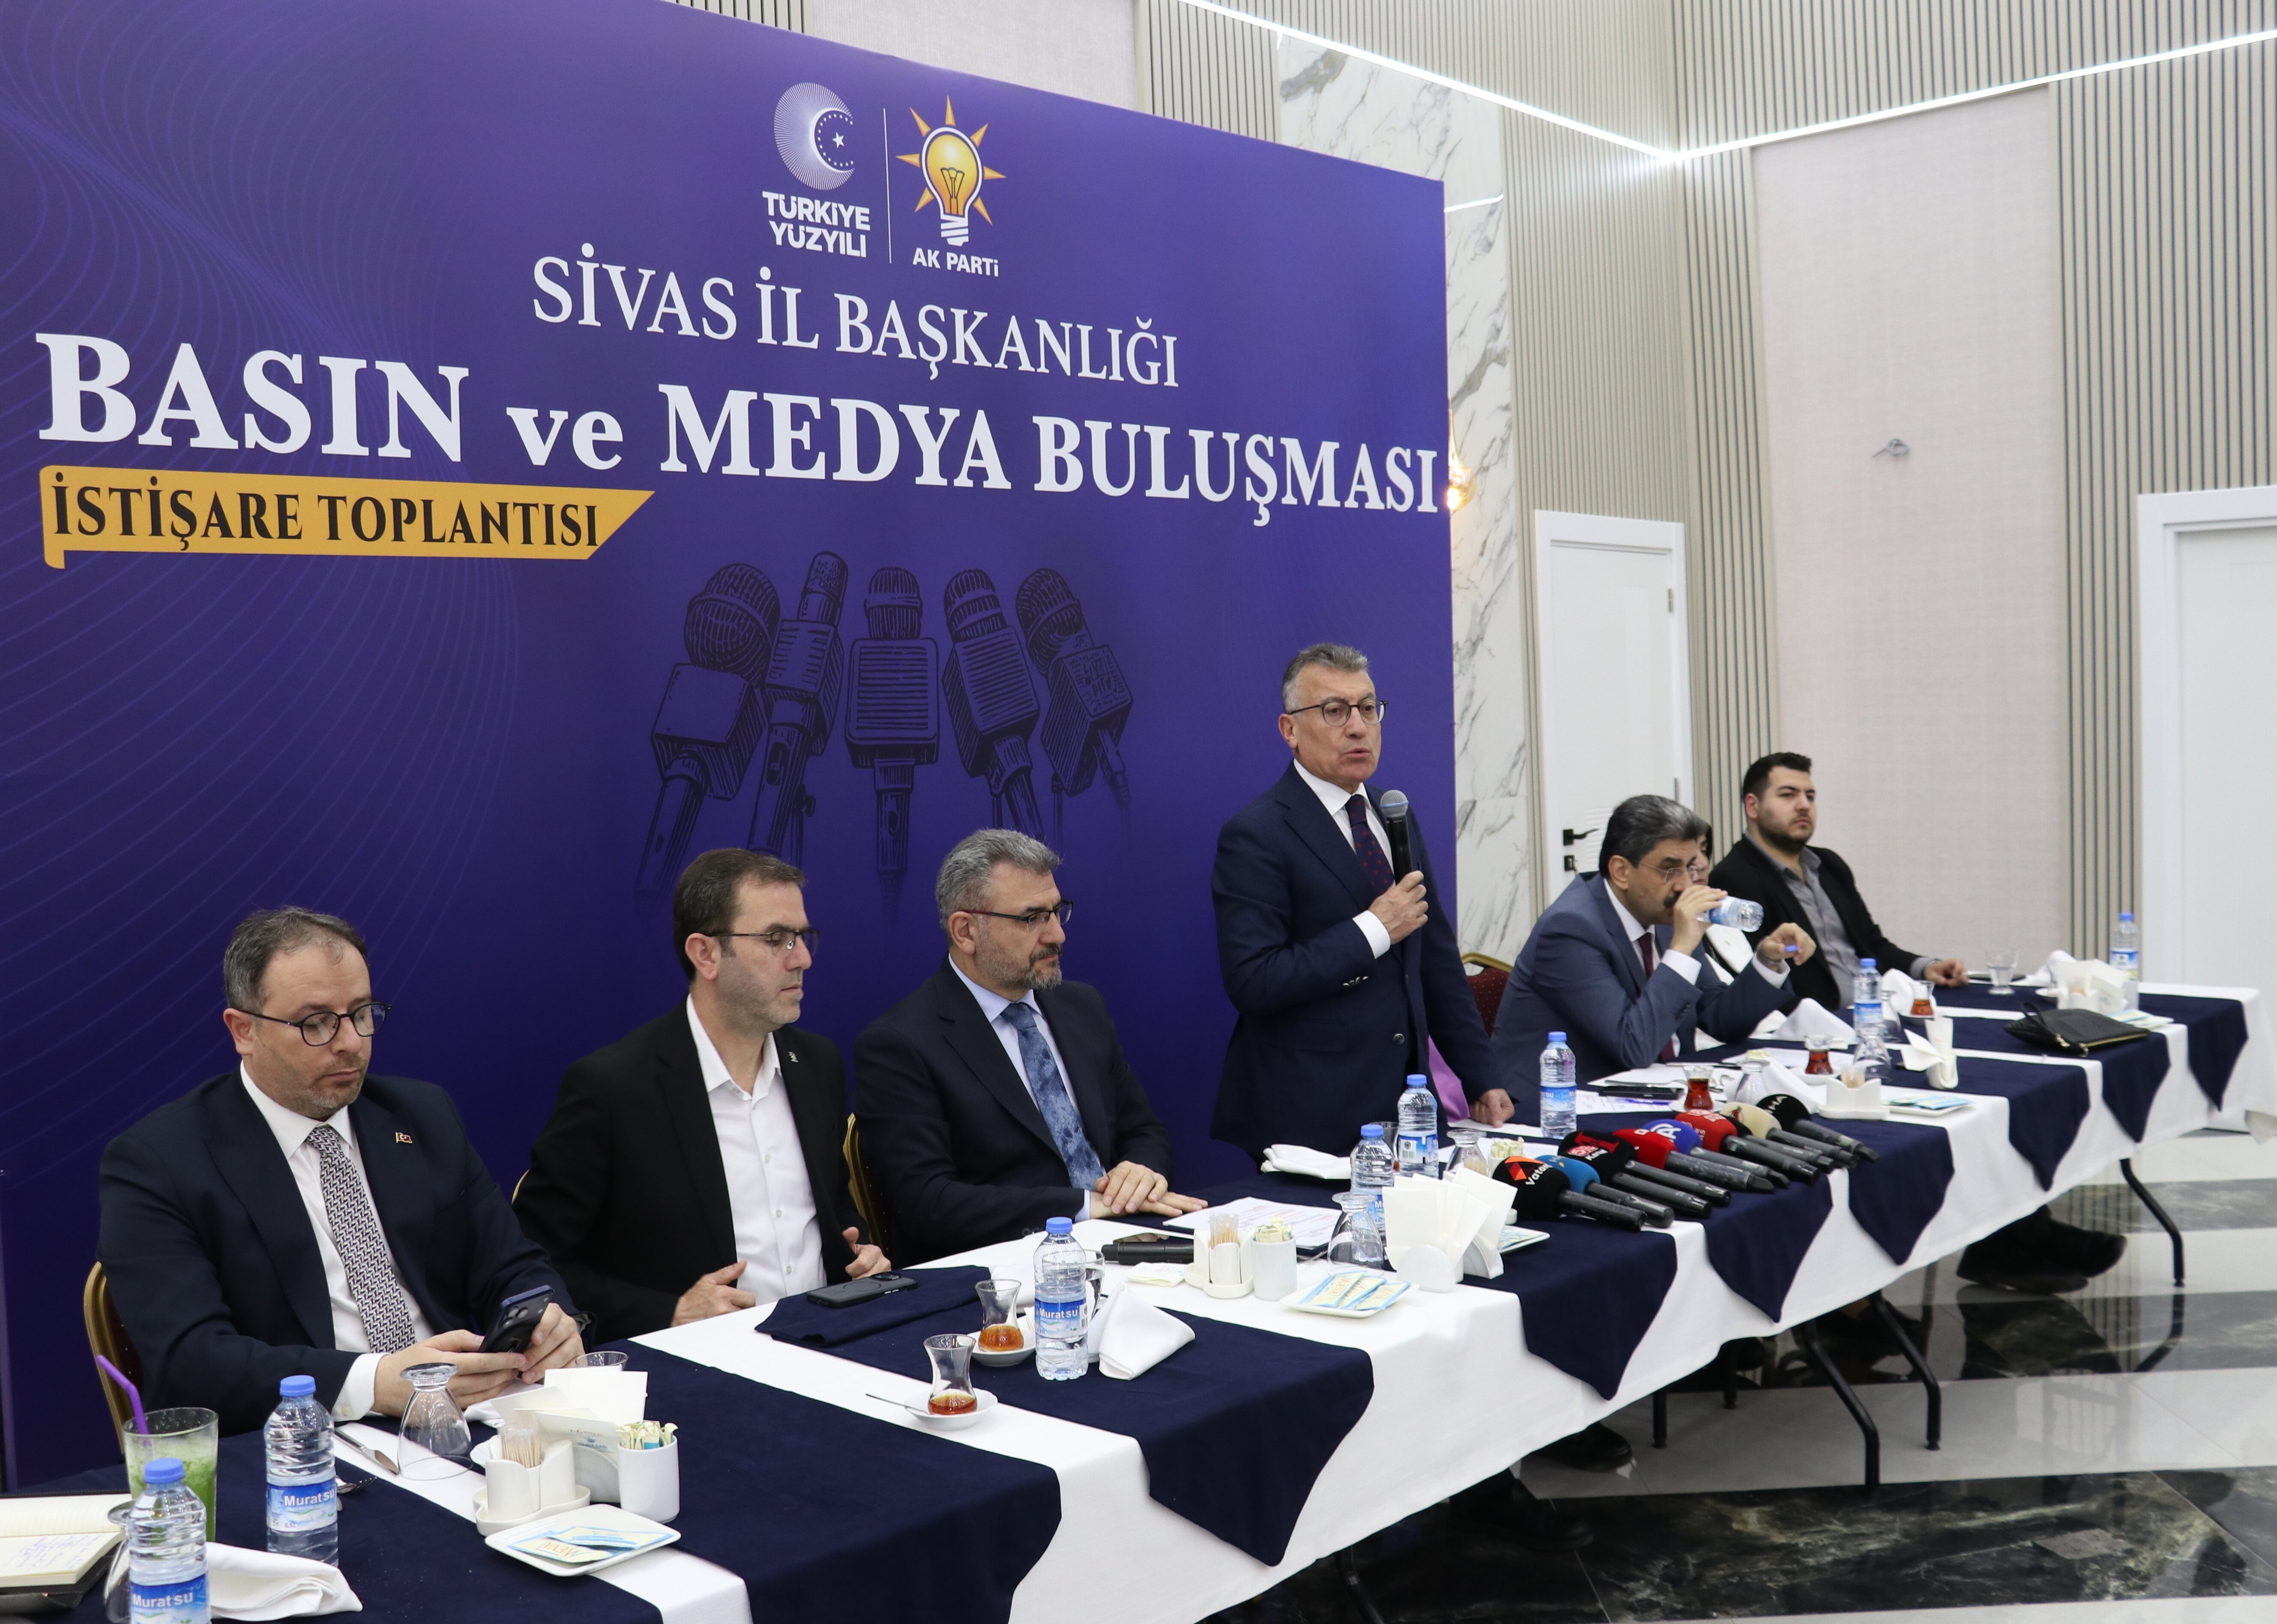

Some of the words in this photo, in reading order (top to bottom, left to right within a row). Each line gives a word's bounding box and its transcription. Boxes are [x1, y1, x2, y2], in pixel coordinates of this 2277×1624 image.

[762, 191, 871, 231] TÜRKİYE
[769, 220, 866, 258] YÜZYILI
[912, 247, 941, 269] AK
[533, 242, 737, 340] SİVAS
[755, 266, 819, 349] İL
[834, 293, 1179, 387] BAŞKANLIĞI
[36, 333, 469, 462] BASIN
[506, 407, 623, 470] ve
[658, 383, 1012, 489] MEDYA
[1032, 416, 1438, 526] BULUŞMASI
[51, 471, 303, 551] İSTİŞARE
[318, 495, 600, 547] TOPLANTISI
[1039, 1307, 1064, 1318] Murat
[284, 1494, 322, 1506] Murat
[132, 1593, 171, 1607] Murat
